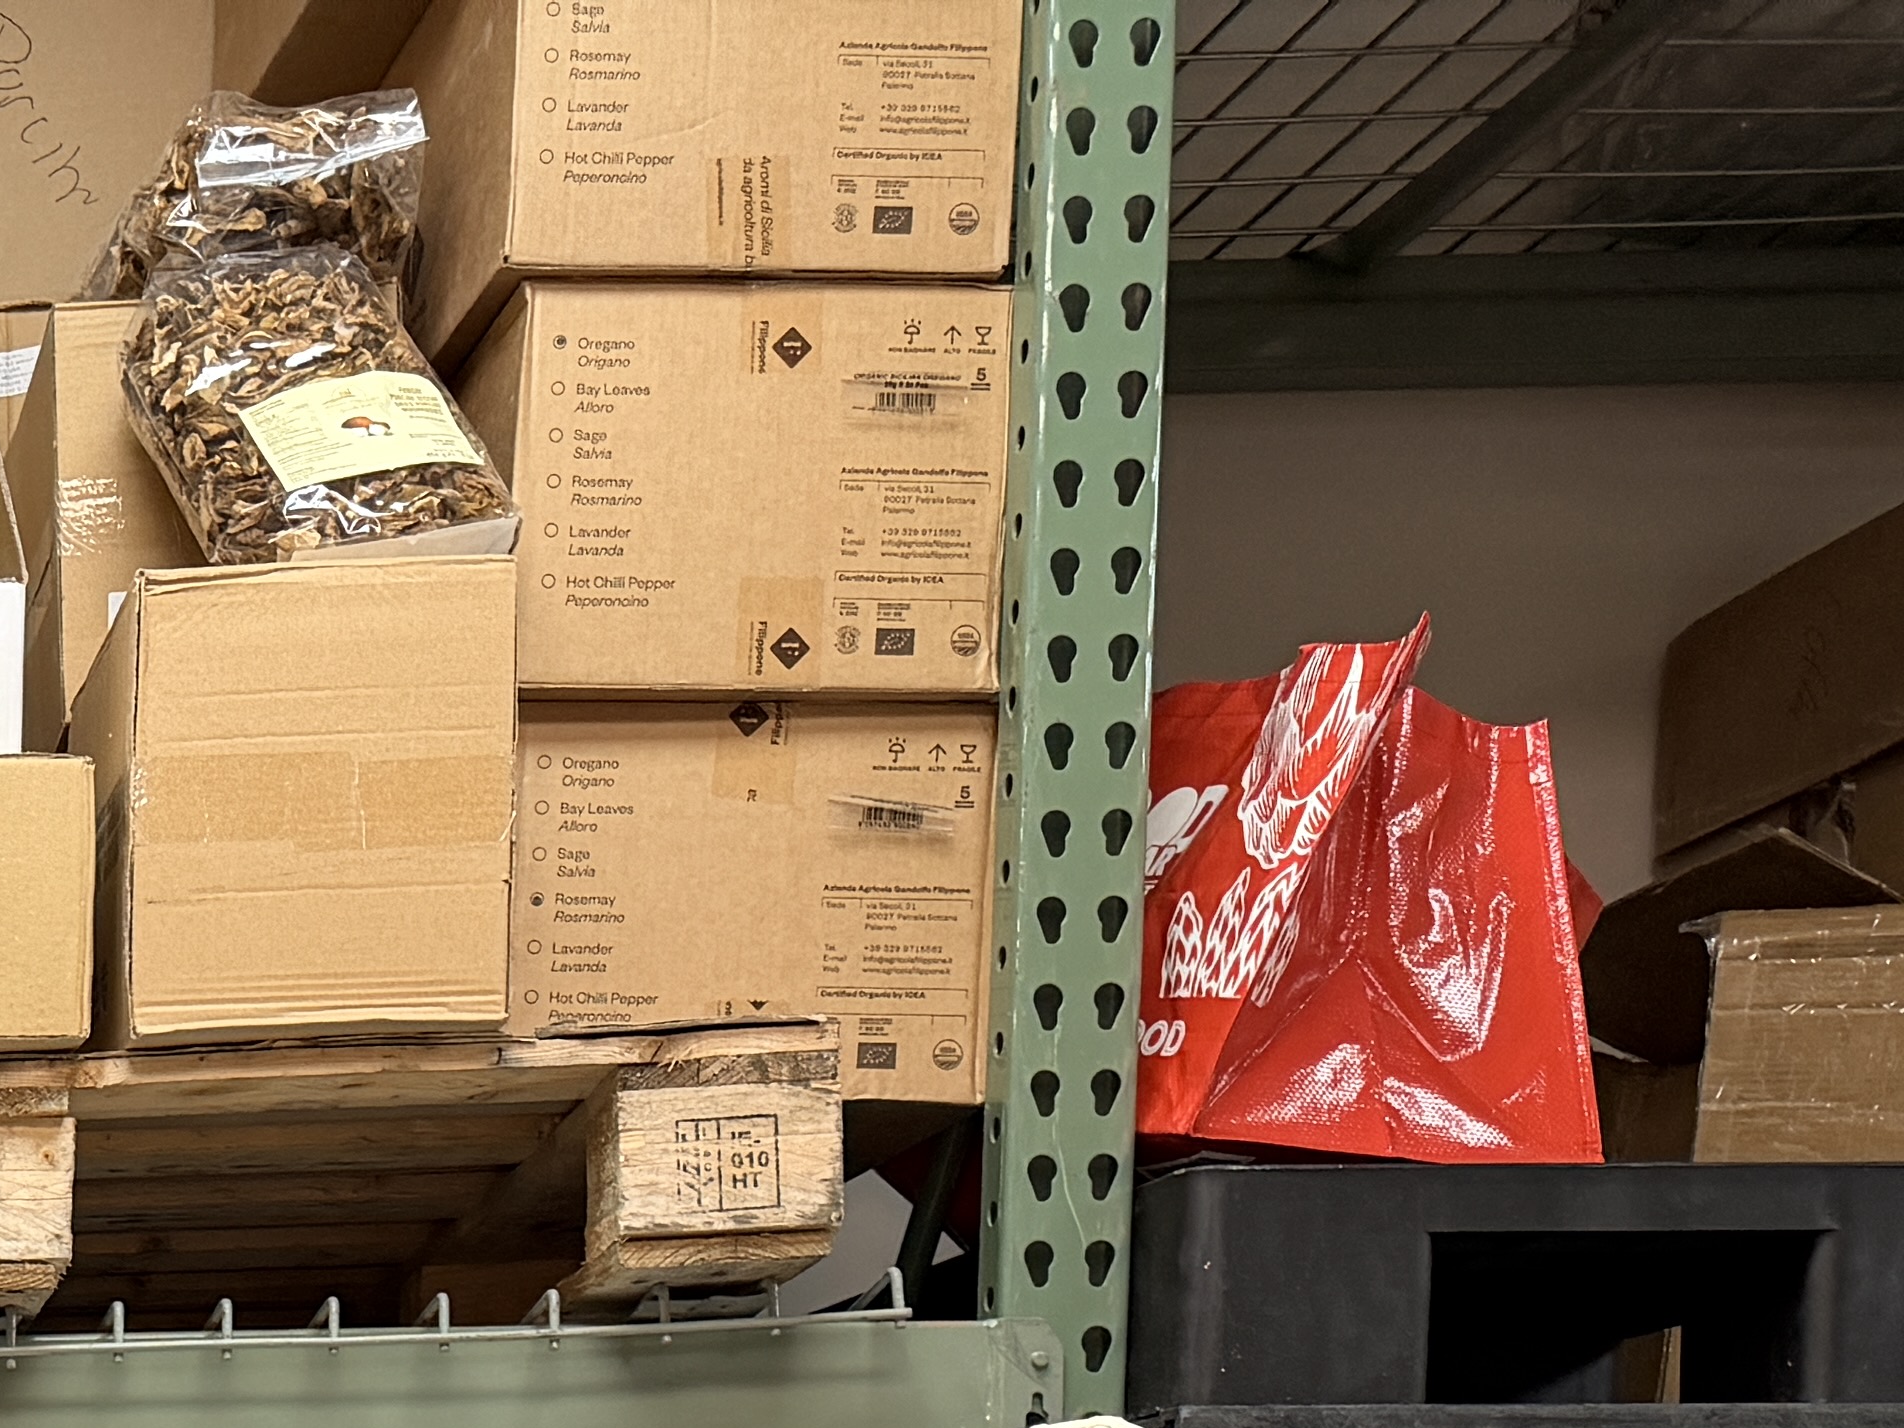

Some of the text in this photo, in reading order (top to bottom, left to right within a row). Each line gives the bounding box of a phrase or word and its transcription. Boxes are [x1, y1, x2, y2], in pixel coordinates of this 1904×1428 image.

[568, 68, 641, 80] Rosmarino
[567, 100, 629, 113] Lavander
[566, 119, 622, 132] Lavanda
[564, 152, 674, 168] Hot Pepper
[578, 337, 635, 353] Oregano
[578, 355, 630, 370] Origano
[976, 368, 986, 381] 5
[576, 383, 651, 398] Bay Leaves
[574, 401, 614, 414] Alloro
[573, 447, 613, 459] Salvia
[571, 475, 633, 490] Rosemay
[570, 494, 643, 506] Rosmarino
[569, 525, 631, 538] Lavander
[568, 544, 624, 556] Lavanda
[566, 576, 676, 592] Hot Pepper
[562, 756, 619, 772] Oregano
[562, 774, 615, 790] Origano
[960, 786, 970, 799] 5
[560, 802, 634, 817] Bay Leaves
[558, 820, 598, 832] Alloro
[556, 865, 596, 878] Salvia
[555, 893, 616, 908] Rosemay
[553, 910, 625, 923] Rosmarino
[552, 942, 613, 955] Lavander
[551, 960, 607, 973] Lavanda
[549, 991, 658, 1007] Hot Pepper
[732, 1171, 763, 1189] HT
